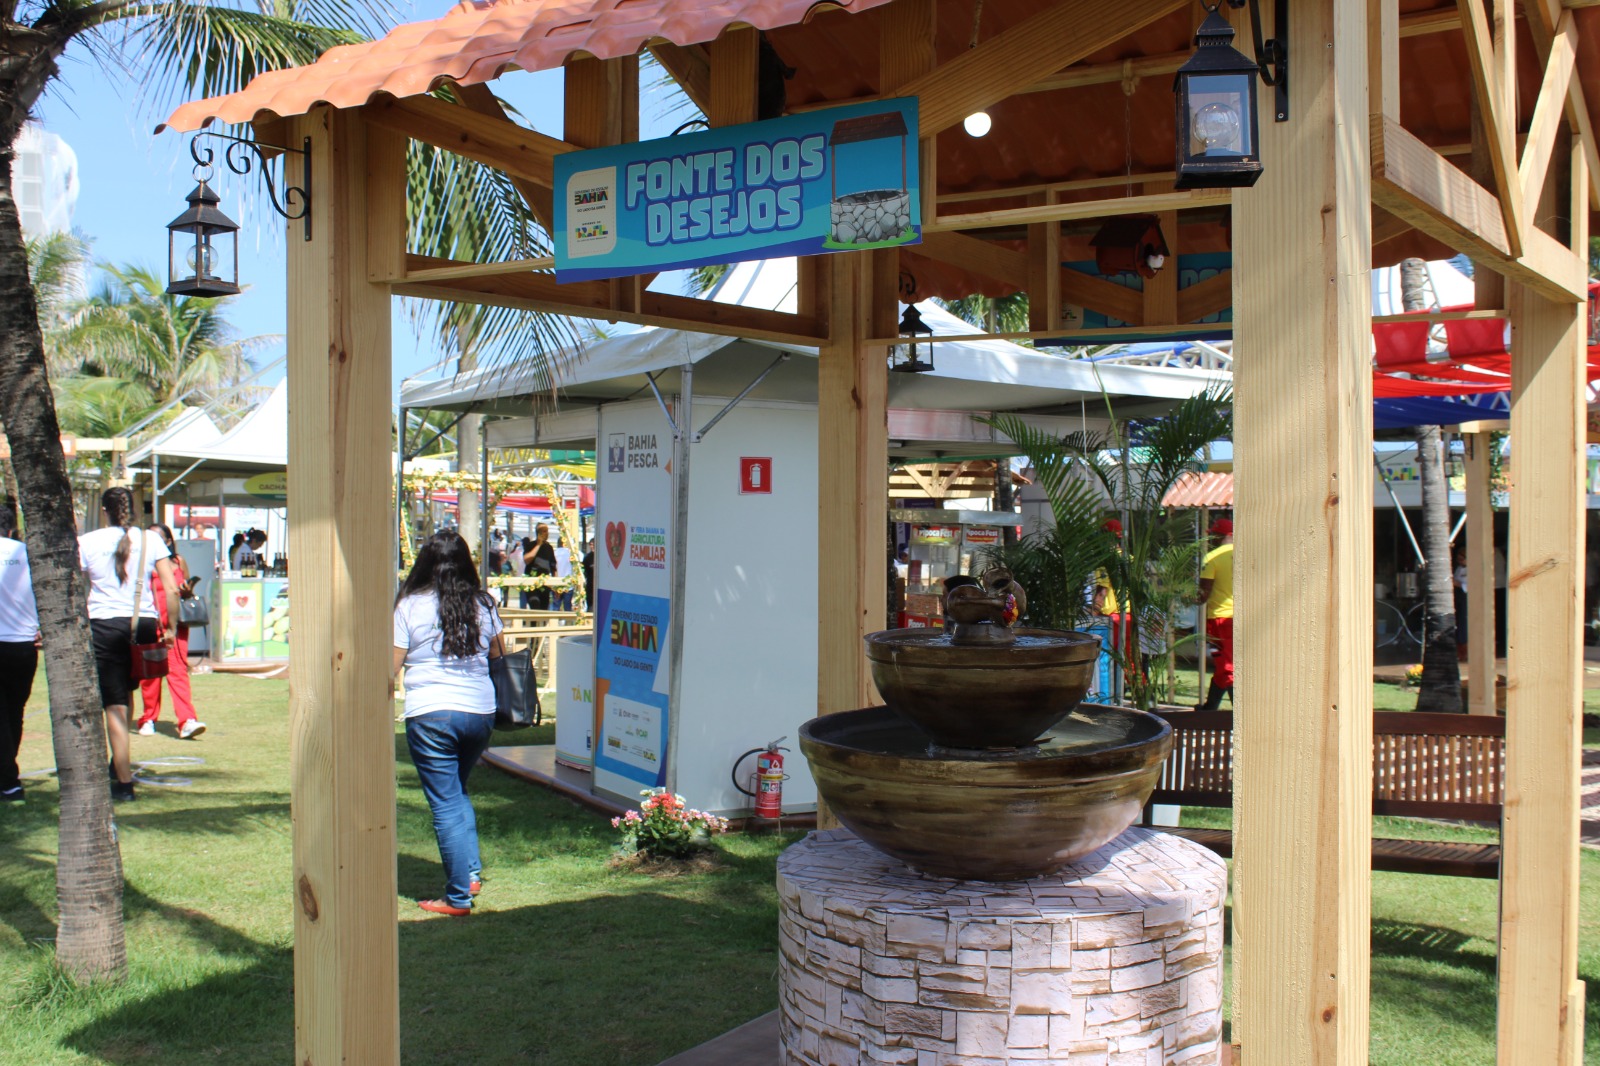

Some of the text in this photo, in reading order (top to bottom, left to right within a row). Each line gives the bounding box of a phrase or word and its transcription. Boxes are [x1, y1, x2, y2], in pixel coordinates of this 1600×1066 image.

[626, 134, 826, 209] FONTE DOS
[574, 191, 609, 206] BAHIA
[647, 184, 802, 245] DESEJOS
[628, 434, 657, 450] BAHIA
[627, 452, 659, 469] PESCA
[630, 534, 666, 546] AGRICULTURA
[630, 544, 666, 562] FAMILIAR
[611, 609, 658, 625] GOVERNO DO ESTADO
[611, 618, 658, 653] BAHIA
[614, 656, 654, 673] DO LADO DA GENTE
[583, 688, 592, 703] N
